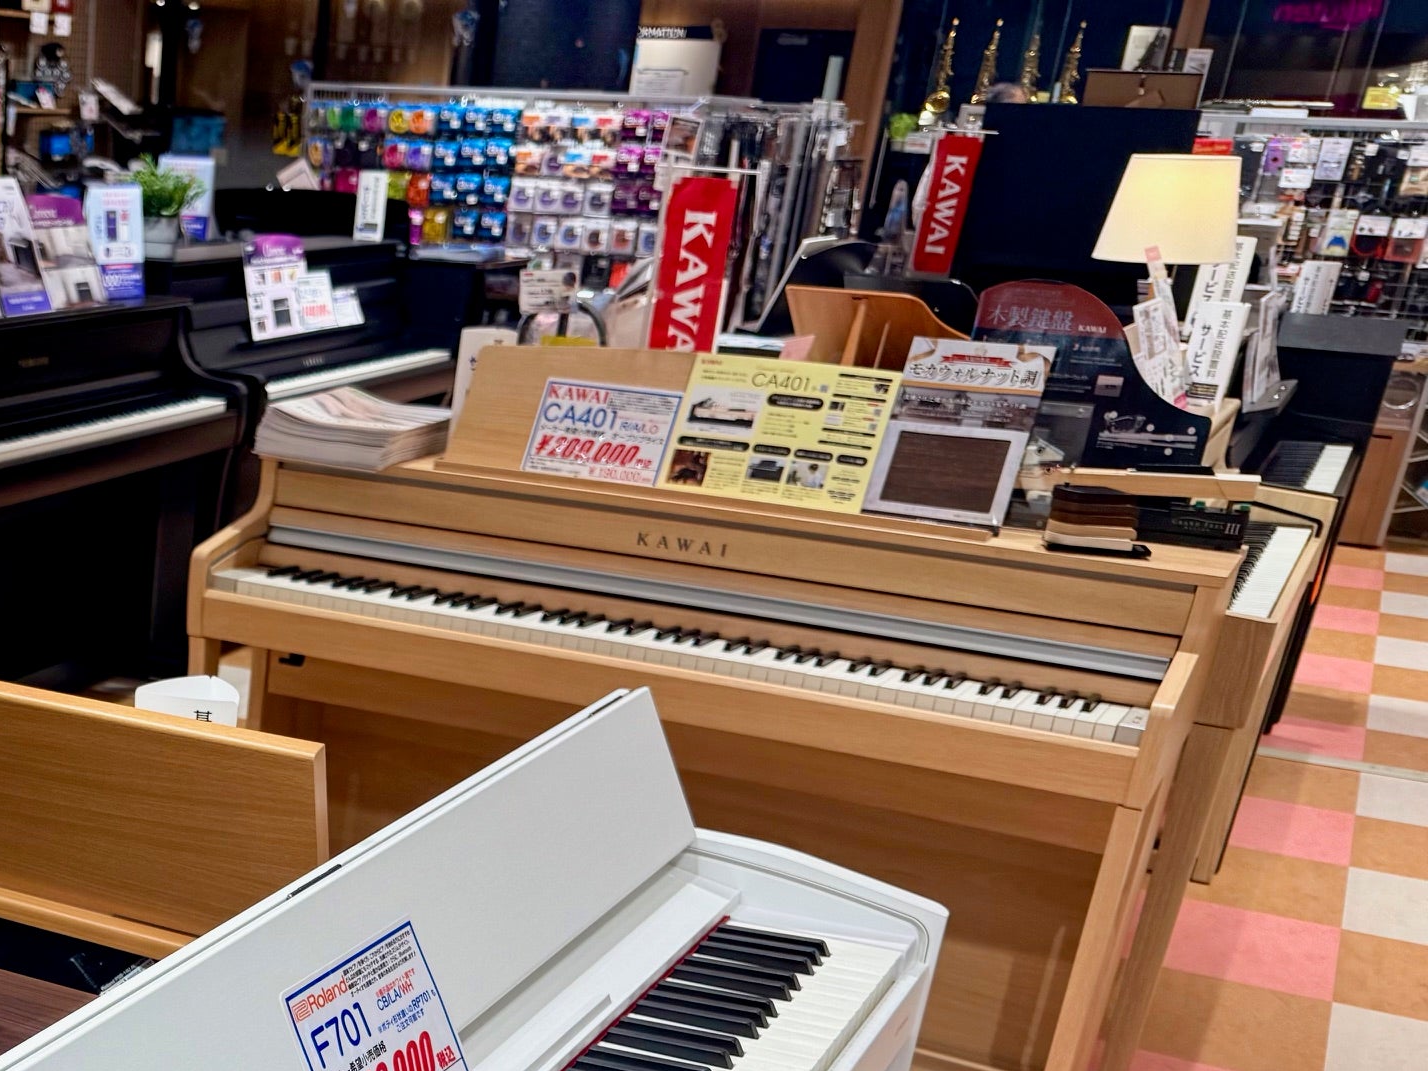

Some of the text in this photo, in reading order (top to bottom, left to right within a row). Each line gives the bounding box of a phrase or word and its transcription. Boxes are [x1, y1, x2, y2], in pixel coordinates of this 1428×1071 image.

[639, 27, 686, 39] RMATION
[924, 154, 969, 255] KAWAI
[667, 209, 718, 352] KAWA
[988, 304, 1074, 331] 木製鍵盤
[751, 371, 810, 392] CA401
[909, 362, 1040, 388] モカウォルナット調
[548, 384, 610, 404] KAWAI
[543, 403, 618, 430] CA401
[636, 532, 728, 558] KAWAI
[307, 976, 349, 1014] Roland
[376, 981, 414, 1011] CB/LA/WH
[311, 1002, 371, 1069] F701
[436, 1045, 456, 1070] 税込
